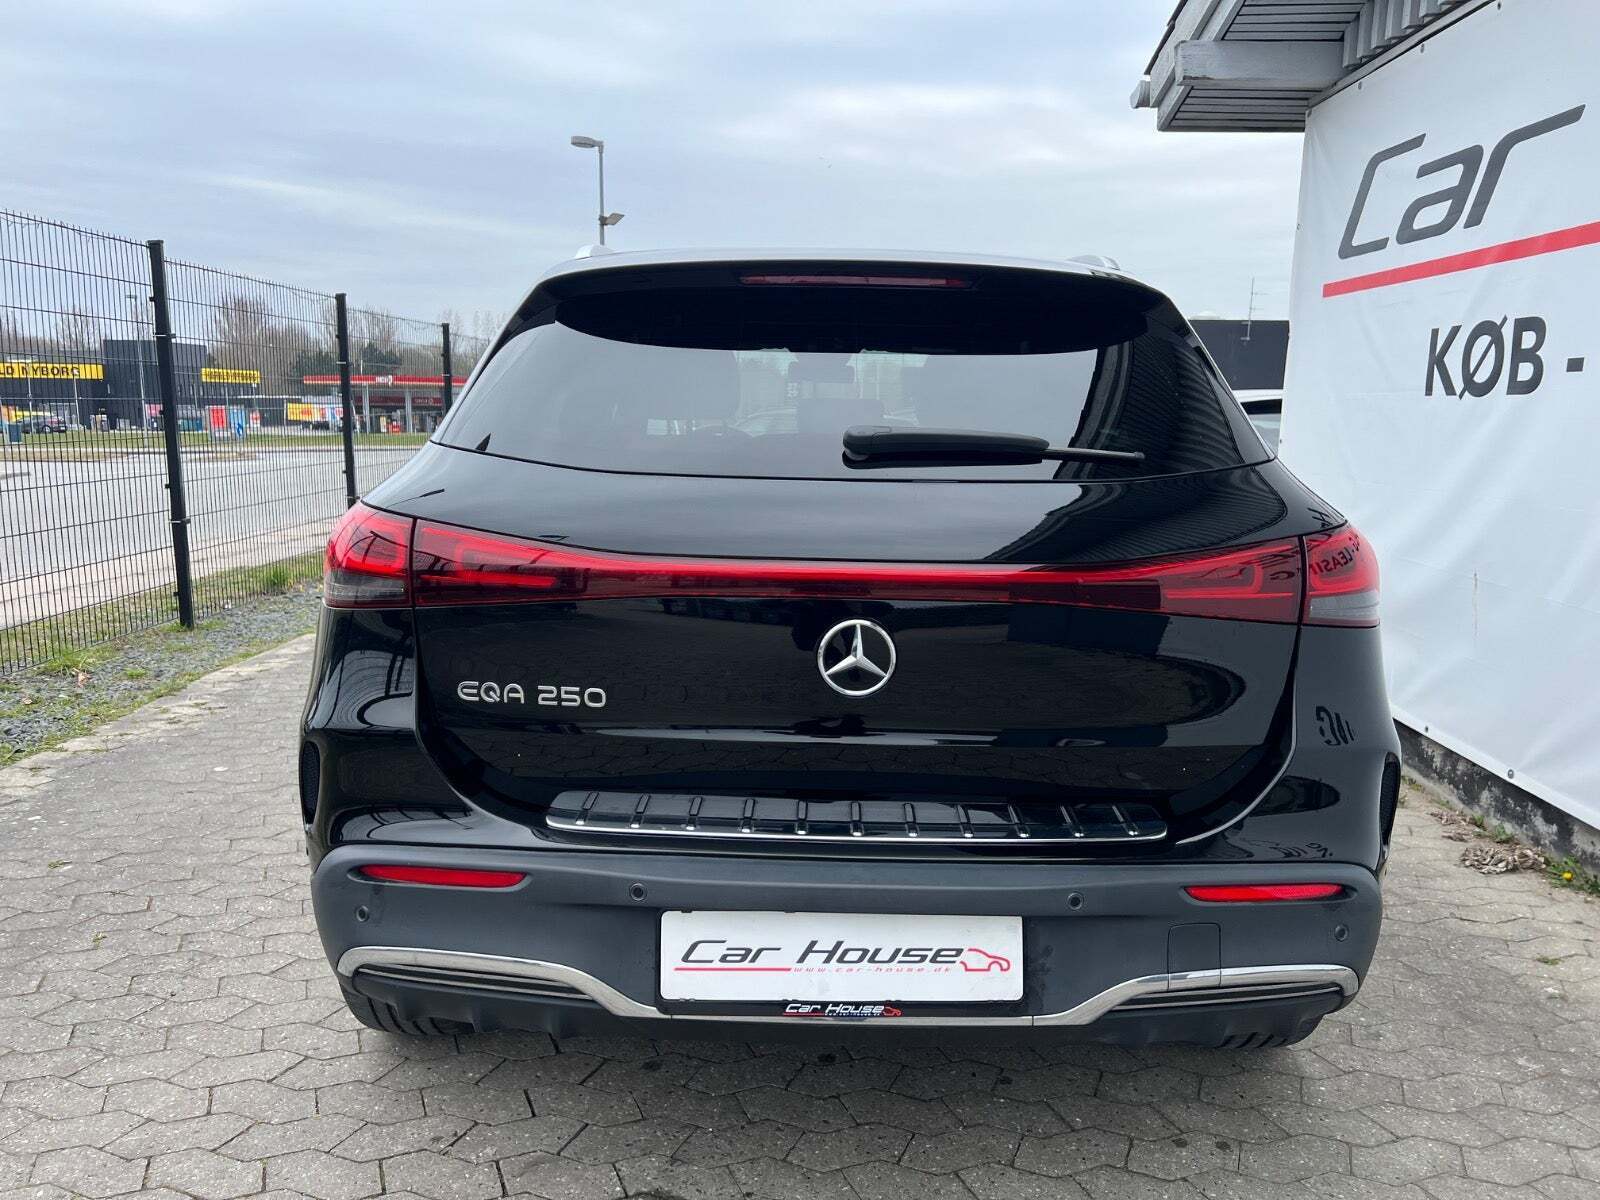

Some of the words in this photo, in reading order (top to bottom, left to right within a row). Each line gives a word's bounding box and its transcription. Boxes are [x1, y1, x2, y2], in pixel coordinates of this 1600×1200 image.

[1338, 104, 1585, 259] Car
[1425, 315, 1546, 400] KØB
[21, 366, 80, 376] NYBORG
[457, 681, 525, 704] EQA
[537, 686, 606, 707] 250
[681, 940, 782, 963] Car
[796, 940, 964, 963] House
[785, 1003, 821, 1013] Car
[825, 1003, 884, 1014] House
